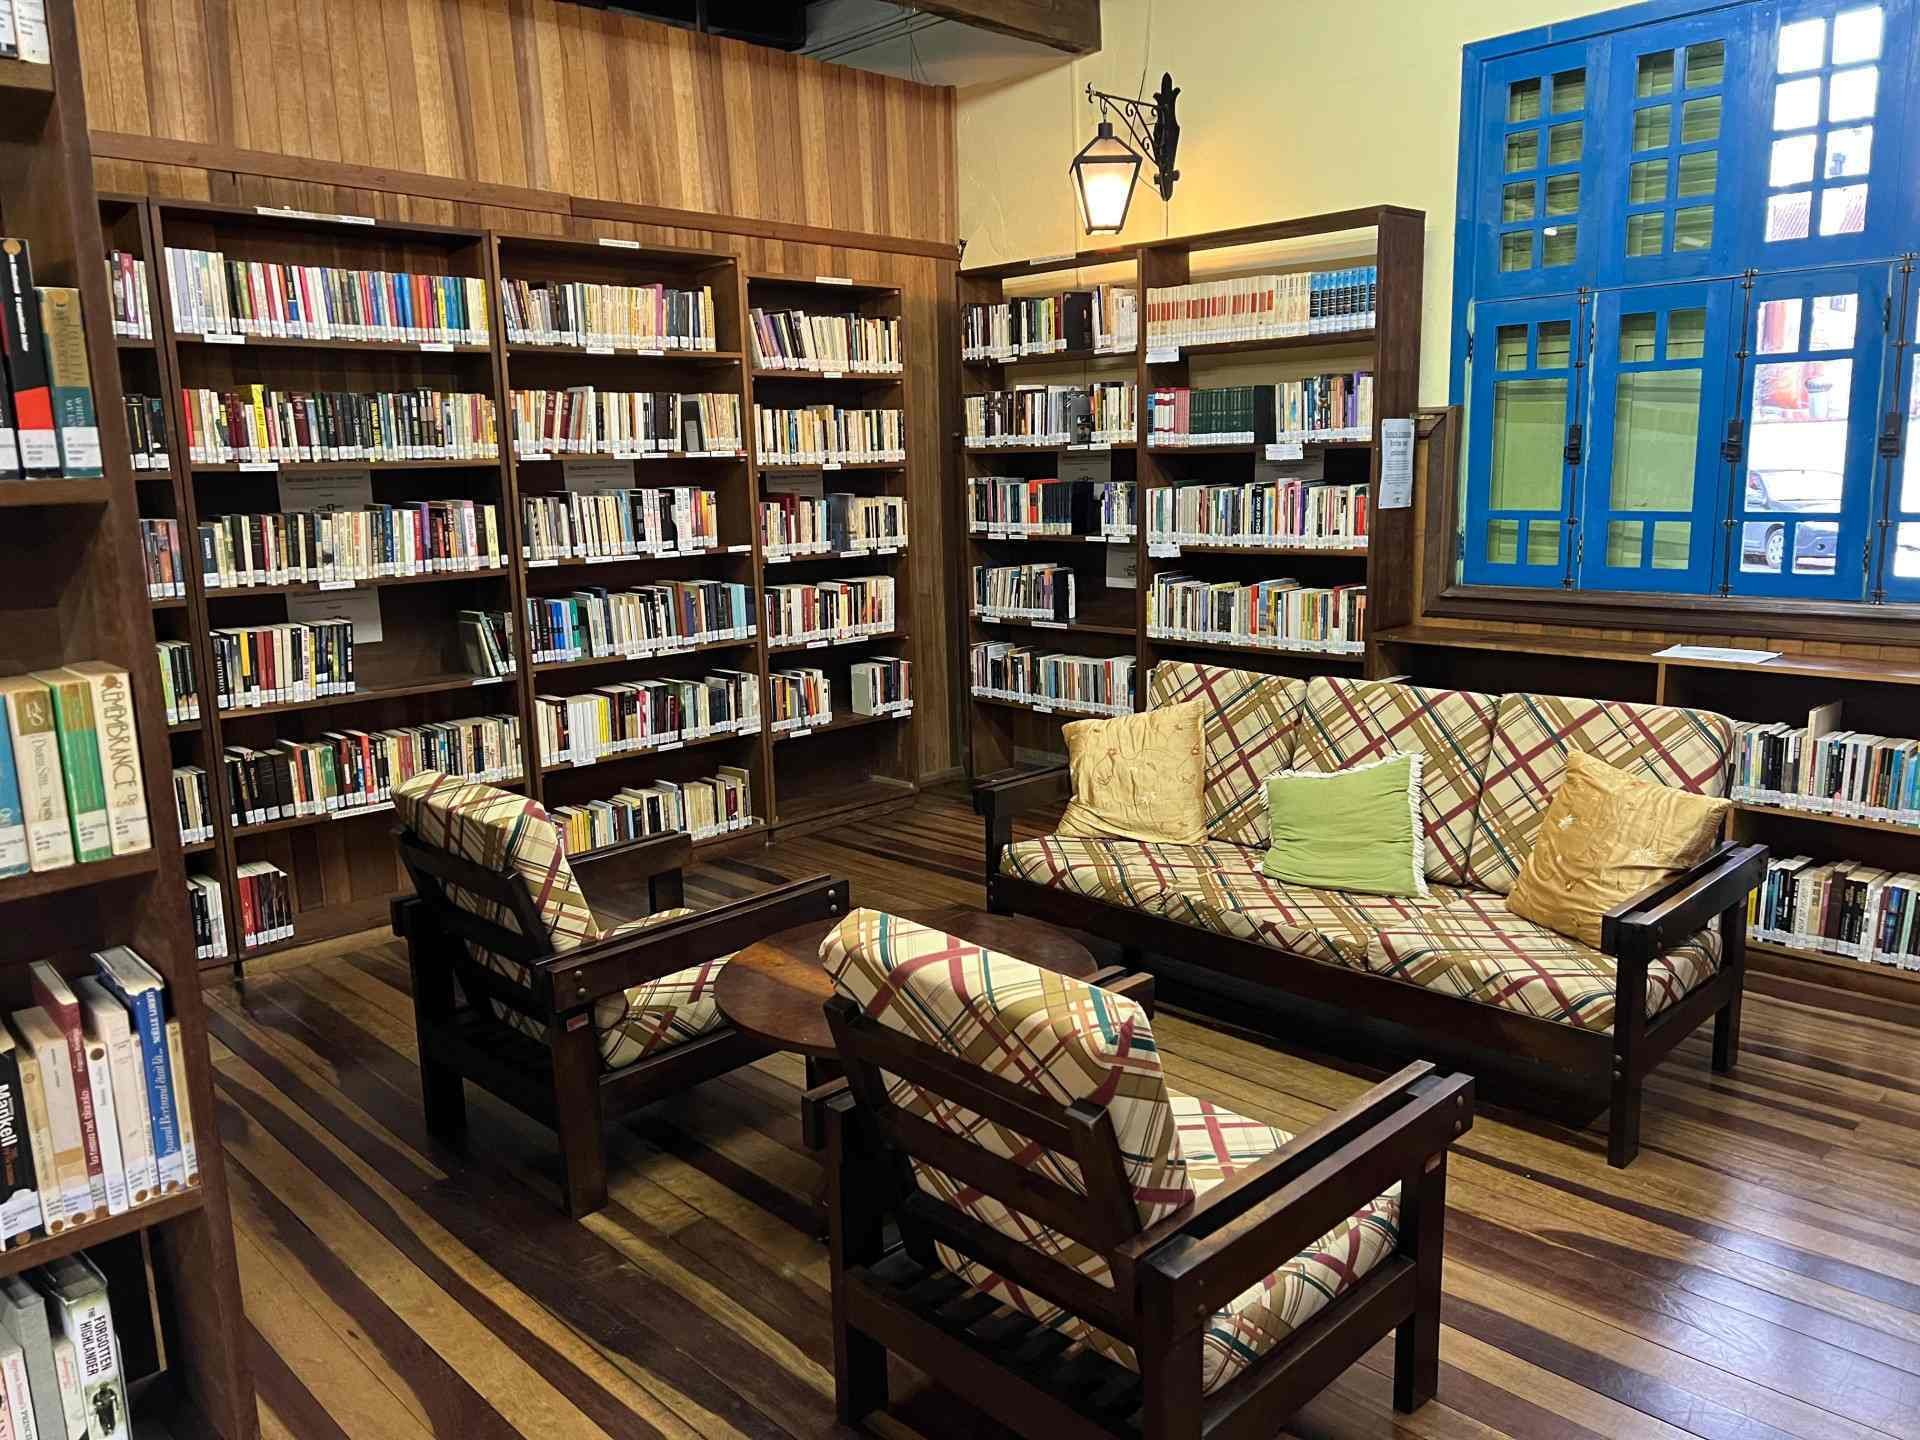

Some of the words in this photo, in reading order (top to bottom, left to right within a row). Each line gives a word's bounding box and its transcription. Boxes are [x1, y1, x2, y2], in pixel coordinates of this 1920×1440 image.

[0, 1084, 18, 1147] Mankell
[80, 1320, 99, 1377] HIGHLANDER
[94, 1314, 113, 1371] FORGOTTEN
